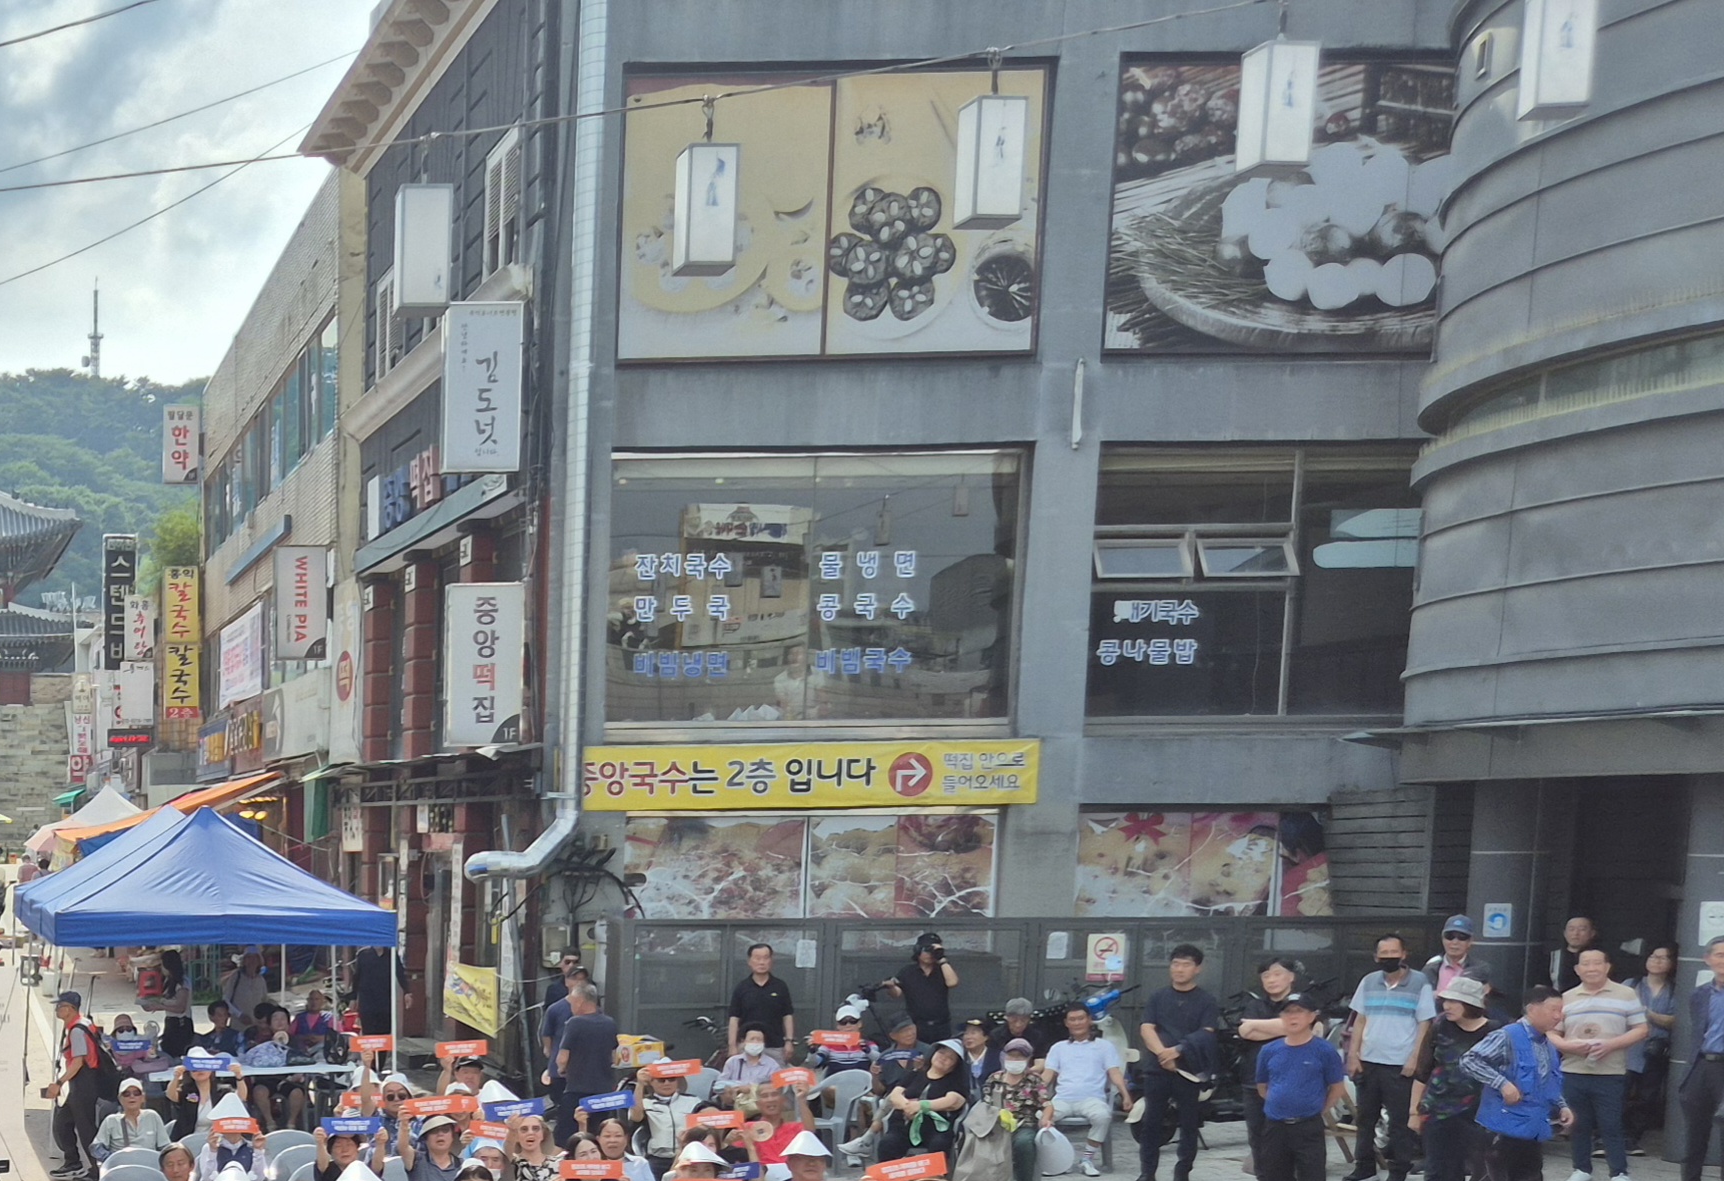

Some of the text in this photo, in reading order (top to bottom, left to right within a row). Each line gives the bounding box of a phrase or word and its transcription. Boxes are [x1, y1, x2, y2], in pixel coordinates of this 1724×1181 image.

[474, 350, 499, 446] 김도넛
[171, 425, 190, 471] 한약
[634, 552, 732, 581] 잔치국수
[169, 582, 193, 639] 칼국수
[294, 556, 308, 643] WHITE PIA
[132, 611, 149, 657] 추어탕
[1096, 638, 1199, 666] 콩나물밥
[168, 645, 194, 704] 칼국수
[472, 596, 500, 725] 중앙떡집
[633, 650, 731, 678] 비빔냉면
[814, 646, 913, 675] 비빔국수
[502, 727, 517, 741] 1F
[726, 759, 776, 795] 2층
[784, 756, 877, 793] 입니다
[943, 751, 1026, 771] 떡집 안으로
[942, 773, 1022, 793] 들어오세요
